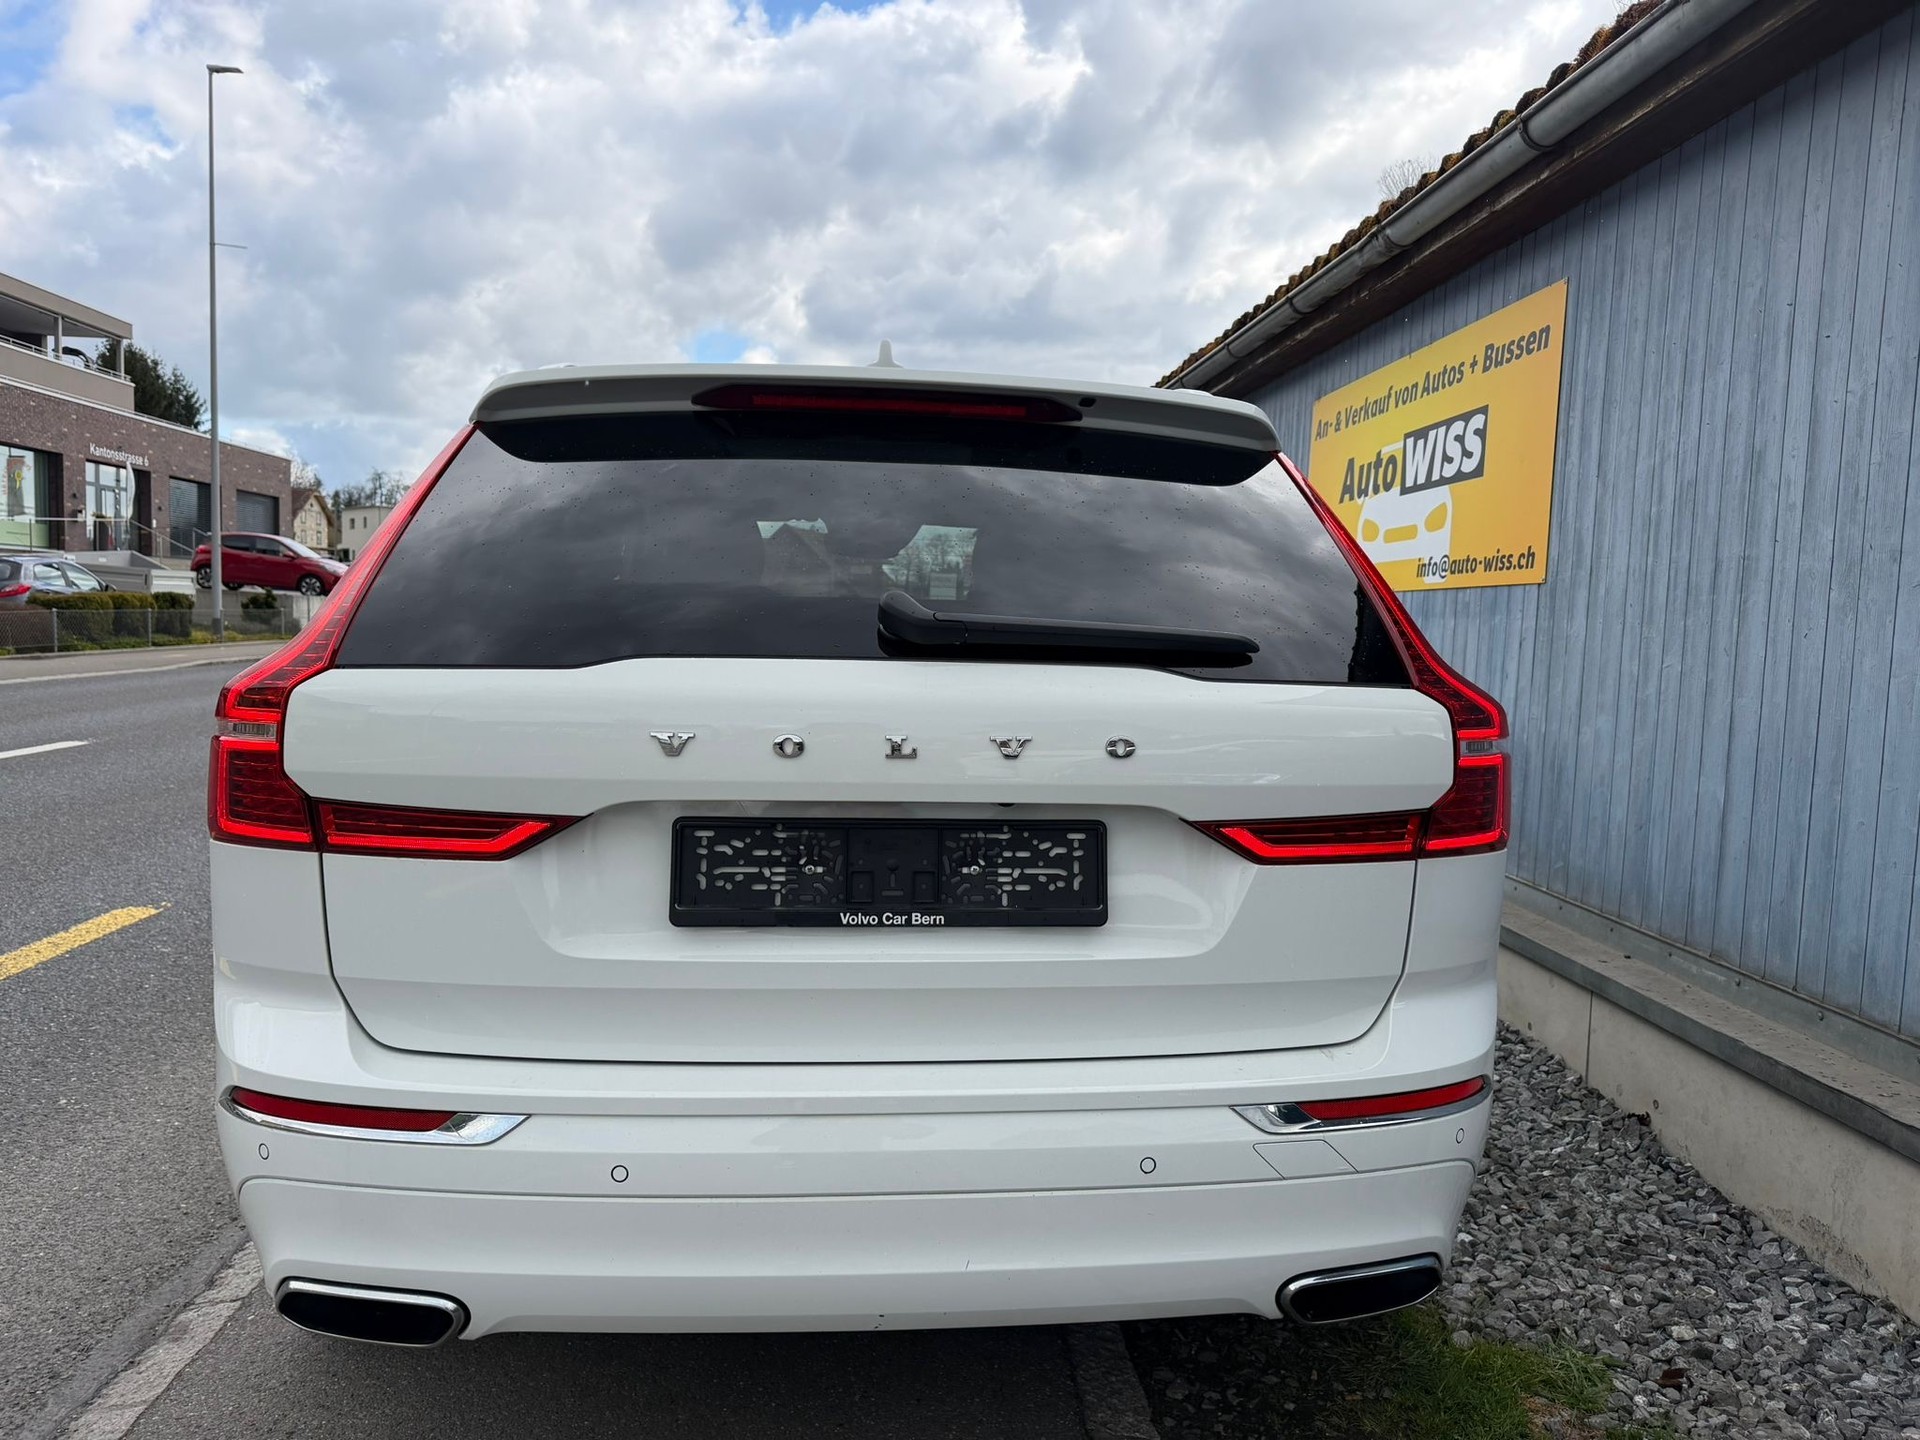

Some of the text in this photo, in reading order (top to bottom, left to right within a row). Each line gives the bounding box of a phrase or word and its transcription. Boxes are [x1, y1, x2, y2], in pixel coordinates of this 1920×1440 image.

[1314, 324, 1551, 441] An- & Verkauf von Autos + Bussen
[90, 442, 149, 467] Kantonsstrasse 6
[1338, 413, 1486, 504] Auto WISS
[1416, 545, 1536, 579] info@auto-wiss.ch
[650, 730, 1137, 759] VOLVO
[840, 912, 944, 925] Volvo Car Bern
